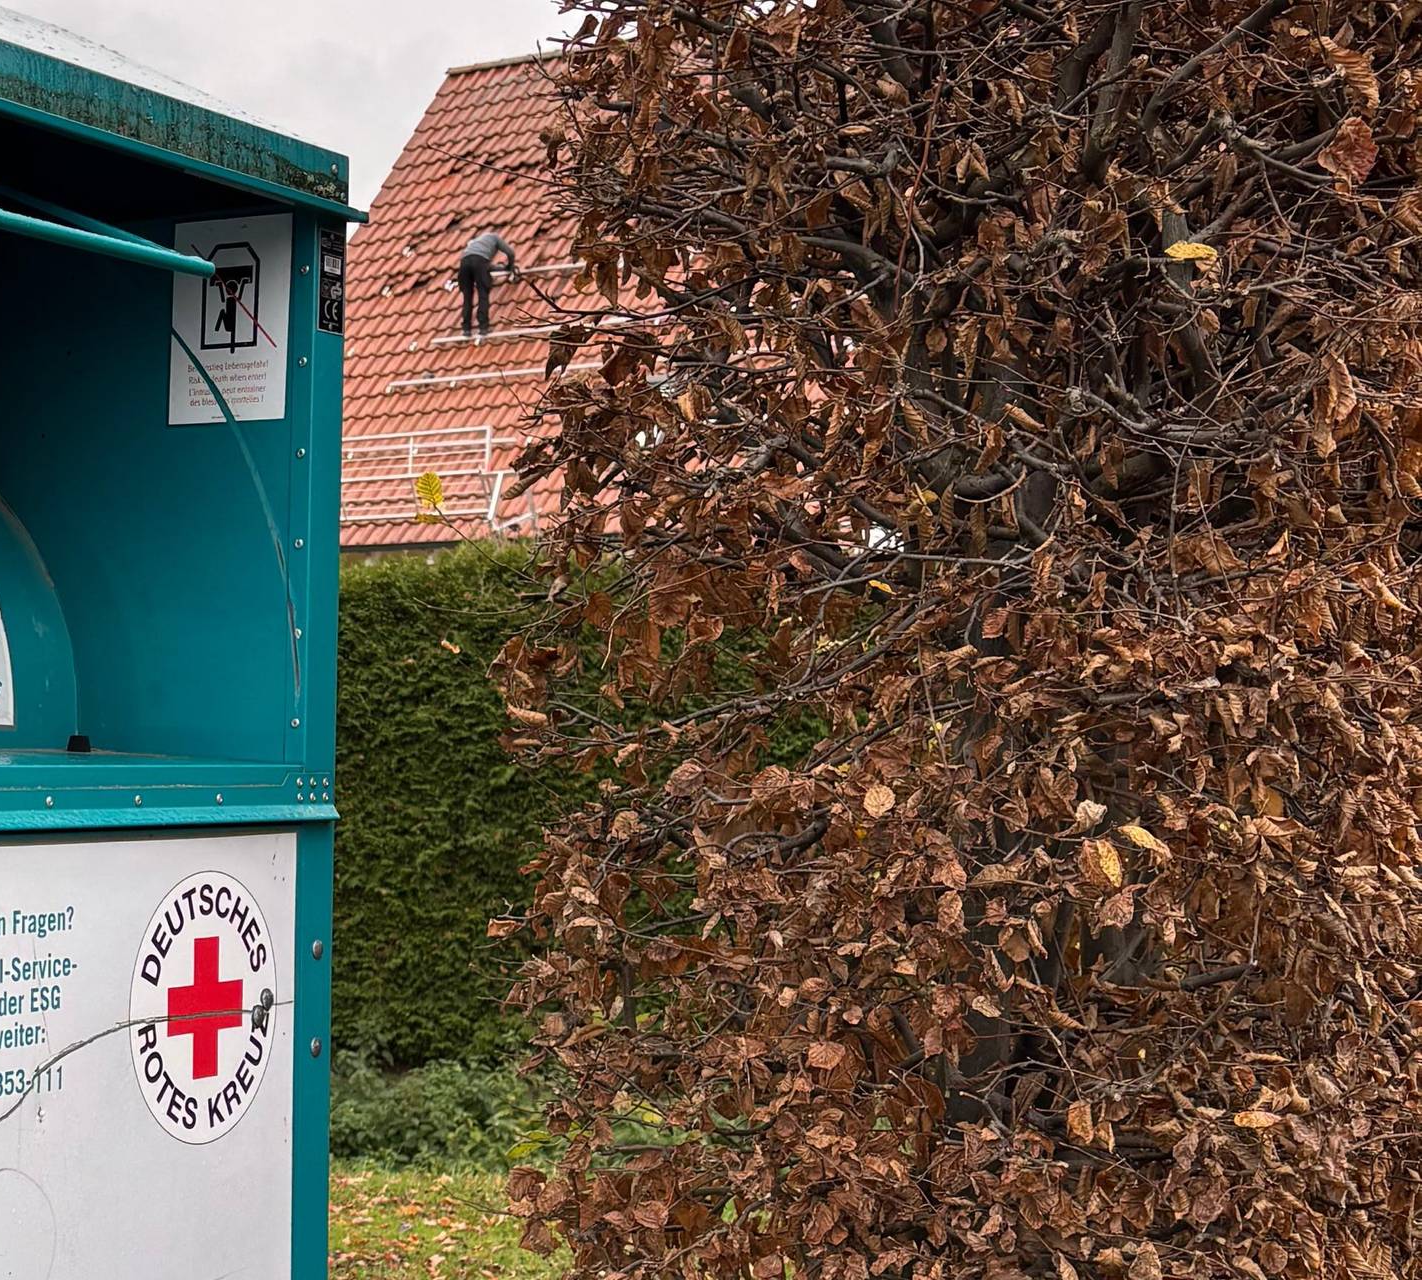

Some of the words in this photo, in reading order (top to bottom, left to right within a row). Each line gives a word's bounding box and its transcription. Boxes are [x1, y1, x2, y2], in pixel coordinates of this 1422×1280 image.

[13, 906, 74, 938] Fragen?
[141, 883, 266, 986] DEUTSCHES
[30, 985, 61, 1012] ESG
[138, 1023, 198, 1130] ROTES
